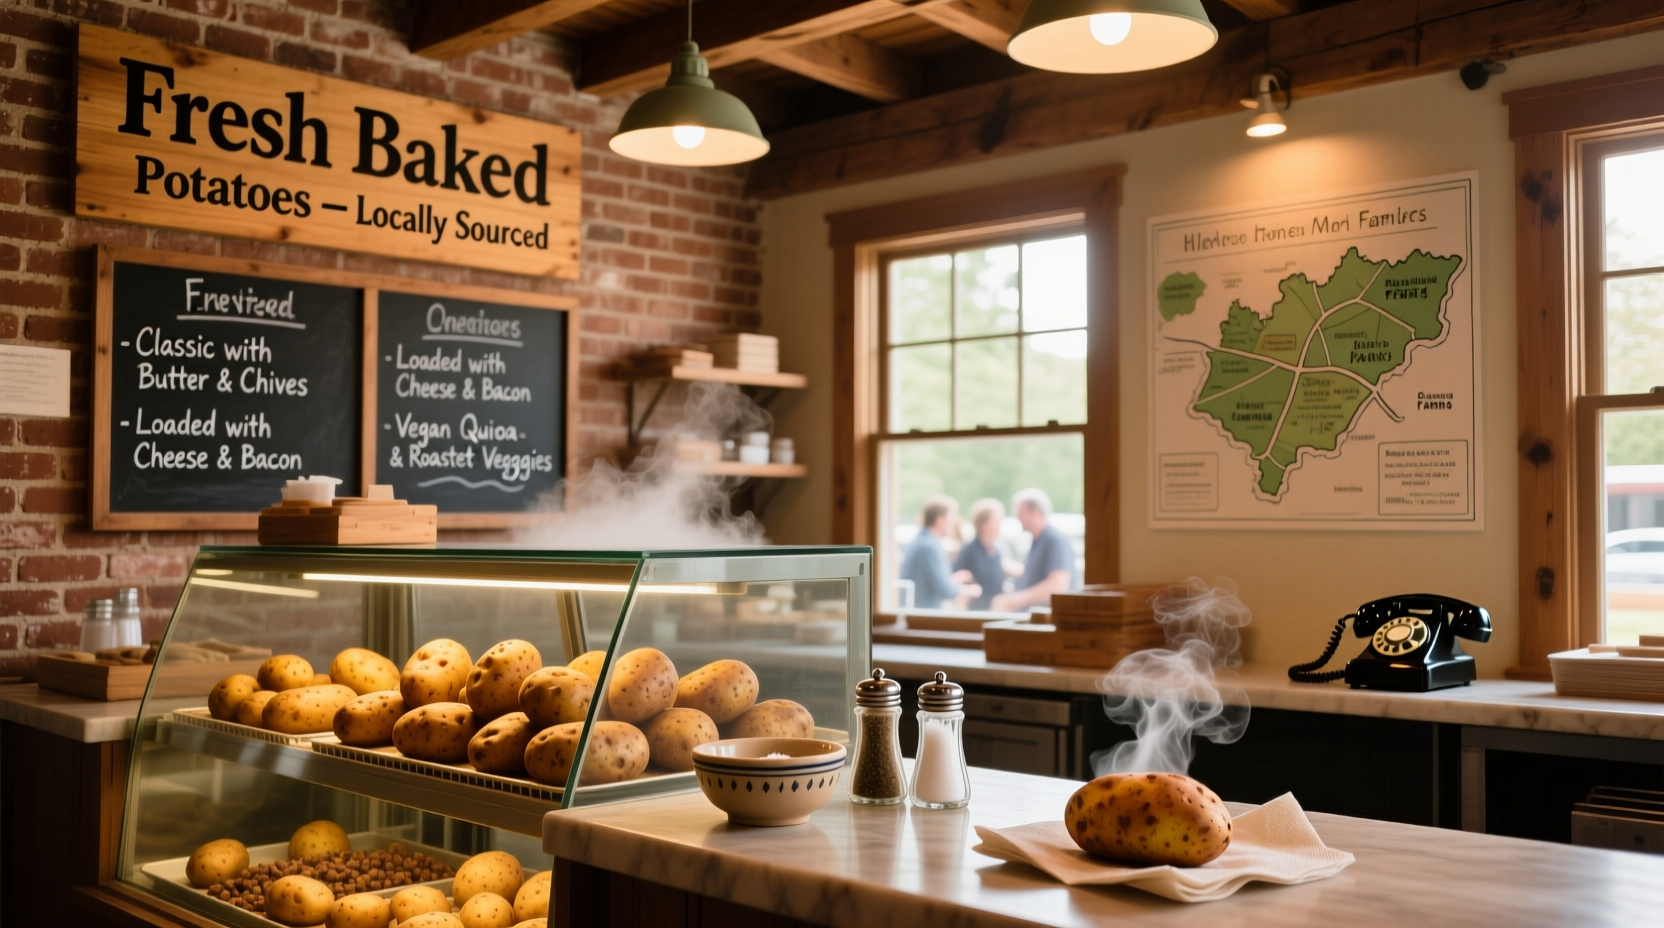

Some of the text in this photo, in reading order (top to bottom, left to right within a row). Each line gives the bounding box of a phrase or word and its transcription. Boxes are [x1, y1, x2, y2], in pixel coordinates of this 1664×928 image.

[118, 57, 550, 206] Fresh Baked
[134, 155, 311, 218] Potatoes
[356, 195, 447, 244] Locally
[455, 210, 548, 250] Sourced
[136, 327, 215, 359] Classic
[224, 336, 272, 363] with
[396, 343, 462, 372] Loaded
[468, 352, 506, 375] with
[137, 362, 308, 396] Butter & Chives
[396, 372, 532, 403] Cheese & Bacon
[136, 407, 216, 437] Loaded
[225, 412, 272, 439] with
[395, 412, 451, 448] Vegan
[134, 441, 302, 470] Cheese & Bacon
[389, 445, 403, 468] &
[409, 444, 474, 468] Roastet
